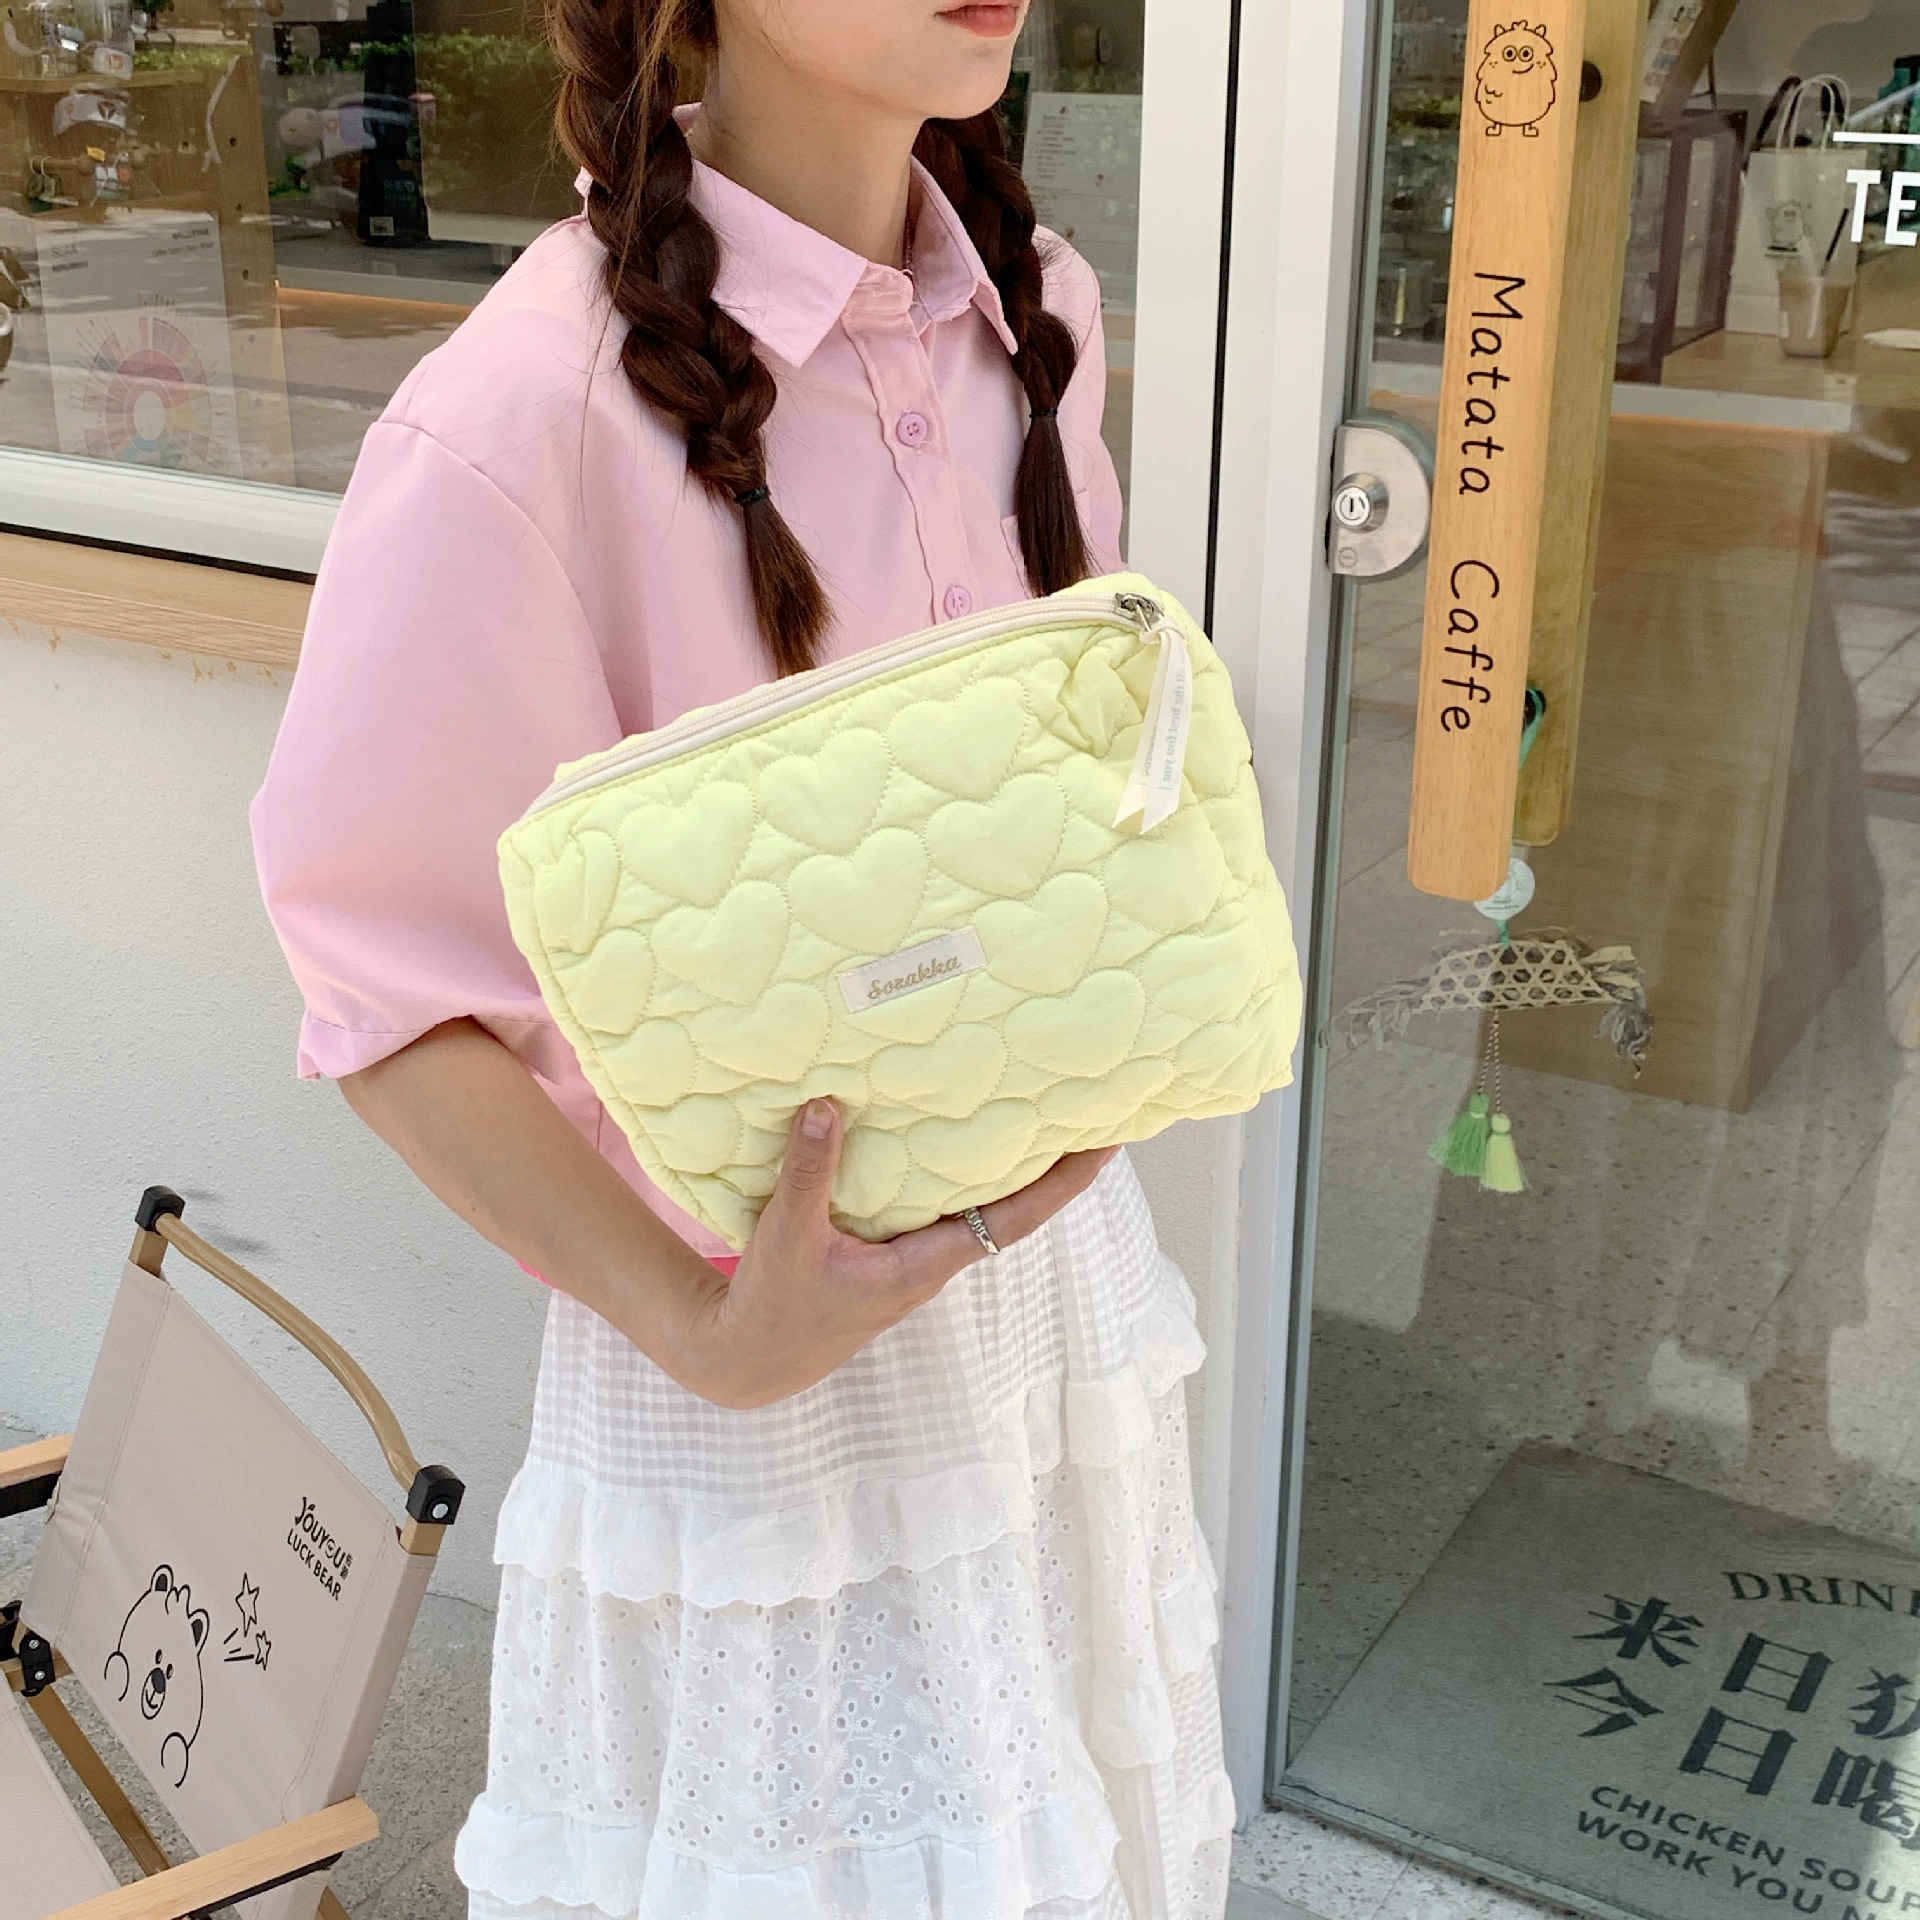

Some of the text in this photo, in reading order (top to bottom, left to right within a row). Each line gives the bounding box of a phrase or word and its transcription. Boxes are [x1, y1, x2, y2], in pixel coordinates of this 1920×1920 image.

[1440, 272, 1526, 732] Matata Caffe
[287, 1528, 342, 1602] LUCK BEAR
[1578, 1811, 1713, 1877] WORK
[1732, 1864, 1823, 1914] YOU
[1591, 1786, 1785, 1867] CHICKEN
